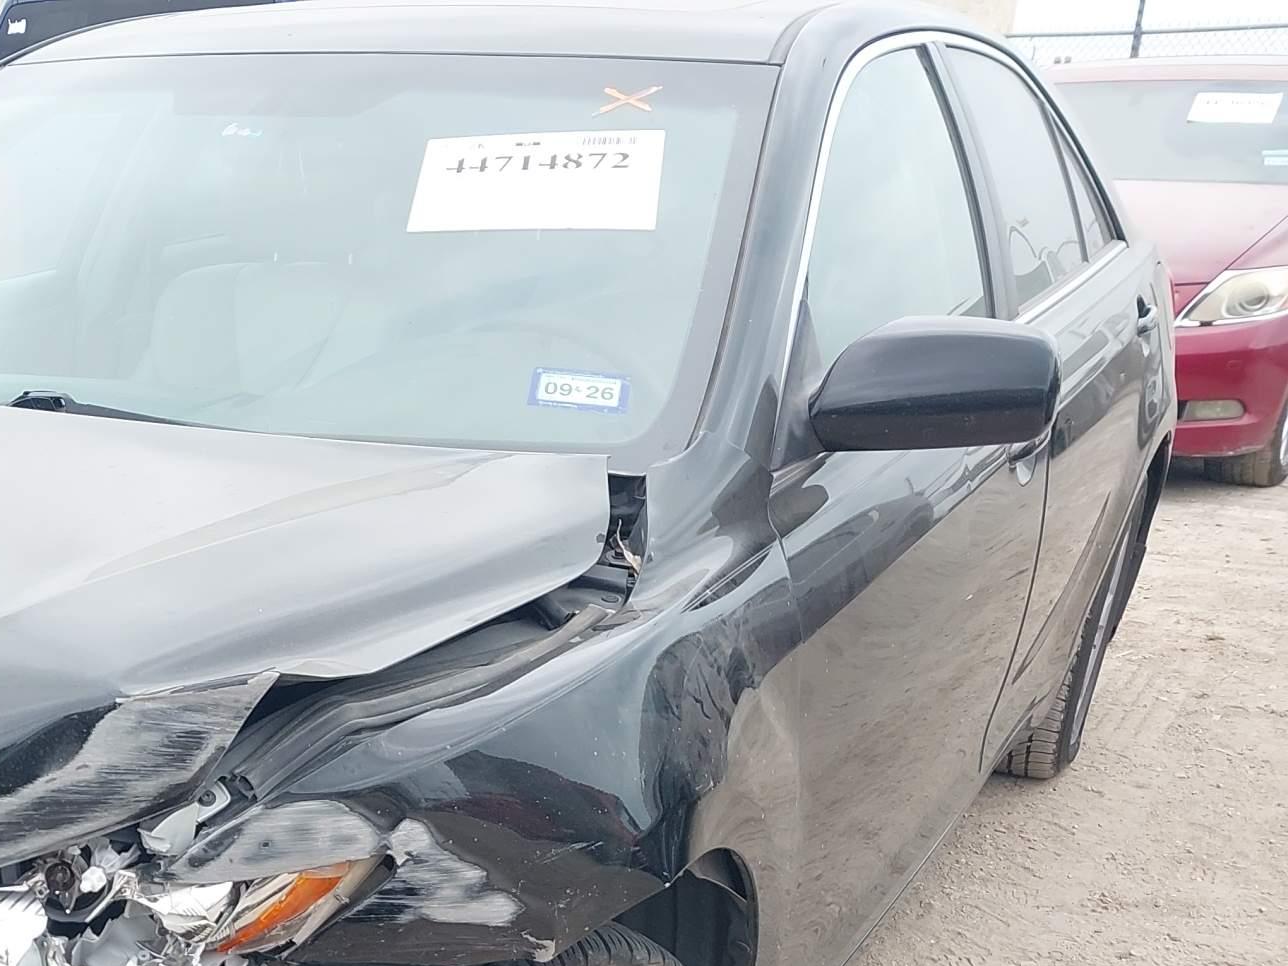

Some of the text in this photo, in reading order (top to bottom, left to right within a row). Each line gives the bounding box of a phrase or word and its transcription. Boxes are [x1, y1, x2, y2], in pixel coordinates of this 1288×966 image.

[445, 151, 631, 174] 44714872
[544, 381, 615, 401] 09 26
